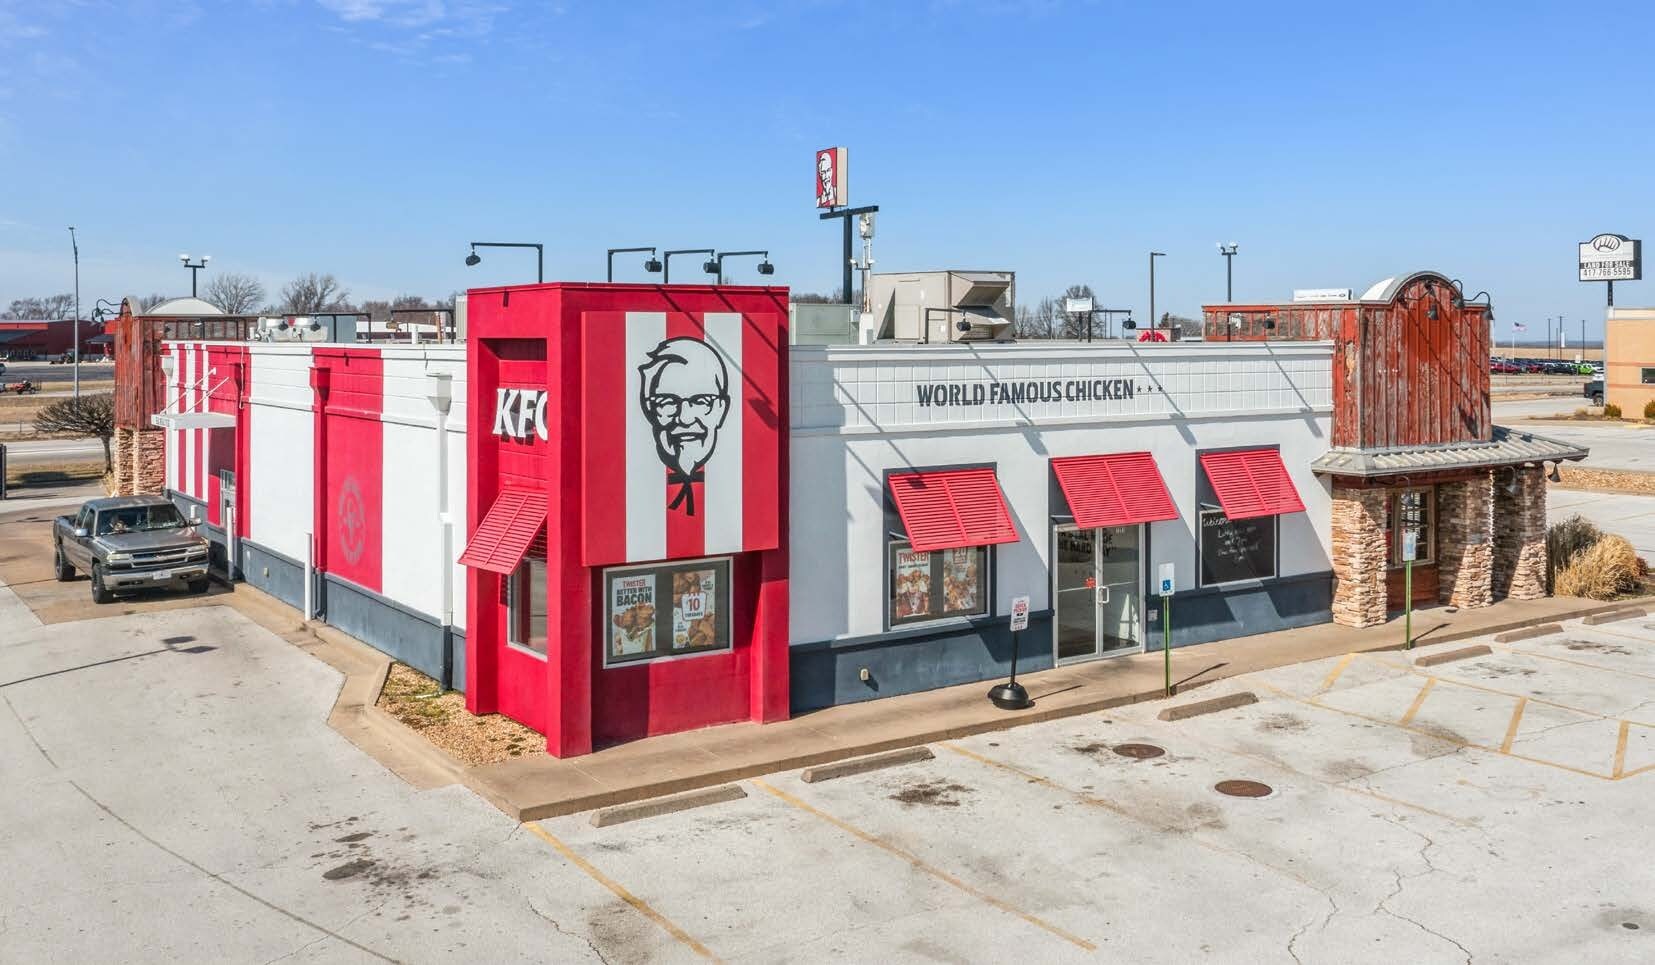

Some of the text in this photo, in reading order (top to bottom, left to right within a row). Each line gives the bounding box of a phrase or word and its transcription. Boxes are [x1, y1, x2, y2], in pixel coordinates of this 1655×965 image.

[1583, 261, 1600, 269] LAND
[1614, 260, 1632, 268] SALE
[916, 379, 1134, 407] WORLD FAMOUS CHICKEN
[899, 552, 929, 563] TWISTER
[623, 579, 646, 588] TWISTER
[617, 586, 653, 596] BETTER WITH
[616, 591, 652, 607] BACON
